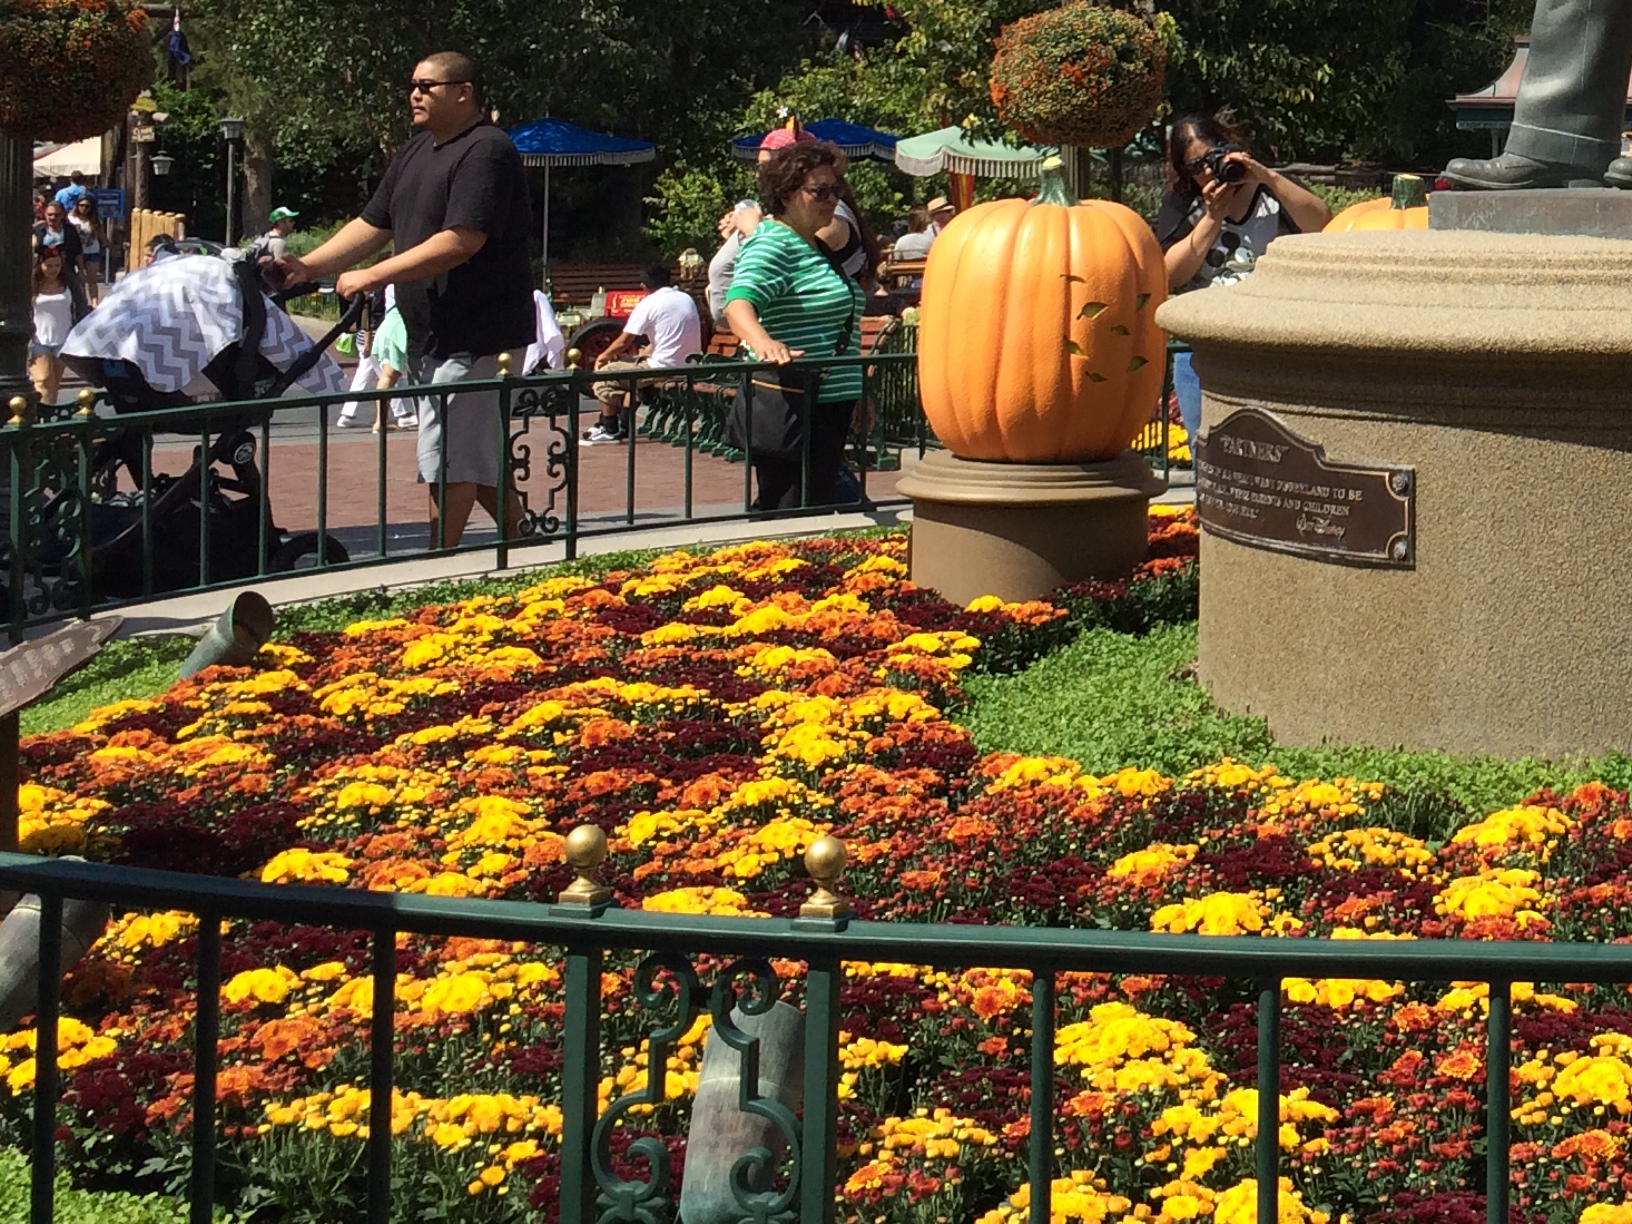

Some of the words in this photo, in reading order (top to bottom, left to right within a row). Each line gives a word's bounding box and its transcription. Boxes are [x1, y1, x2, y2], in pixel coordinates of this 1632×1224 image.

[1332, 488, 1346, 500] TO
[1348, 489, 1363, 501] BE
[1303, 500, 1350, 516] CHILDREN
